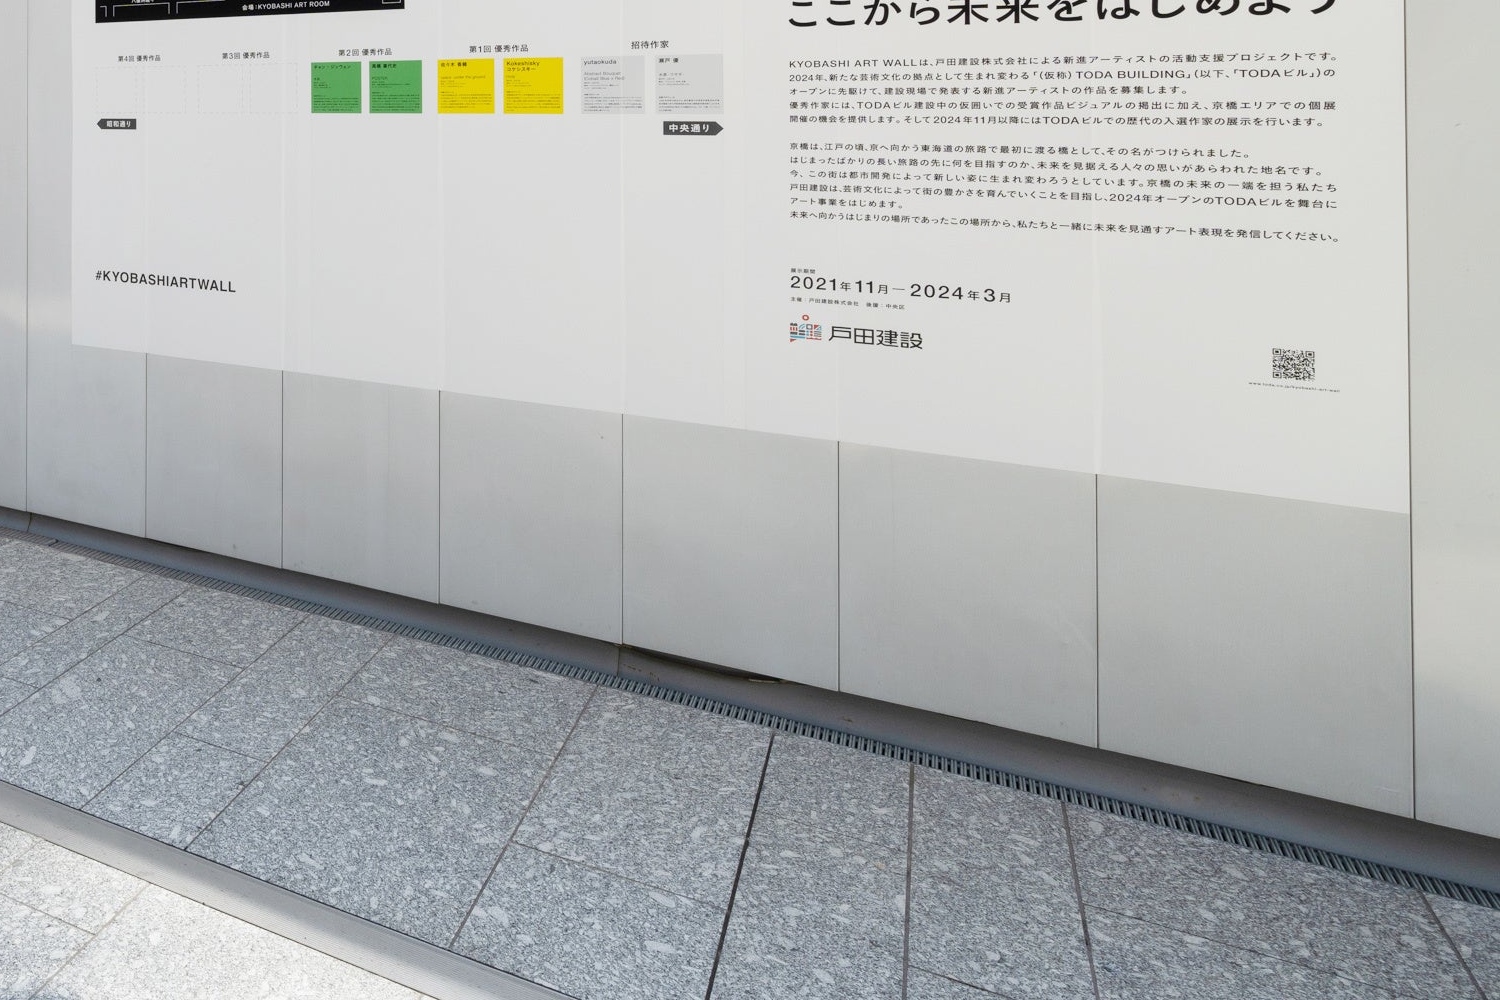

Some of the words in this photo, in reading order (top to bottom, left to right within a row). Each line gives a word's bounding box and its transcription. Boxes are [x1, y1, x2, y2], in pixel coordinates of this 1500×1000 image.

[631, 40, 669, 50] 招待作家
[789, 59, 850, 68] KYOBASHI
[854, 59, 878, 67] ART
[668, 123, 710, 133] 中央通り
[790, 197, 904, 209] アート事業をはじめます。
[95, 269, 236, 294] #KYOBASHIARTWALL
[828, 325, 923, 350] 戸田建設
